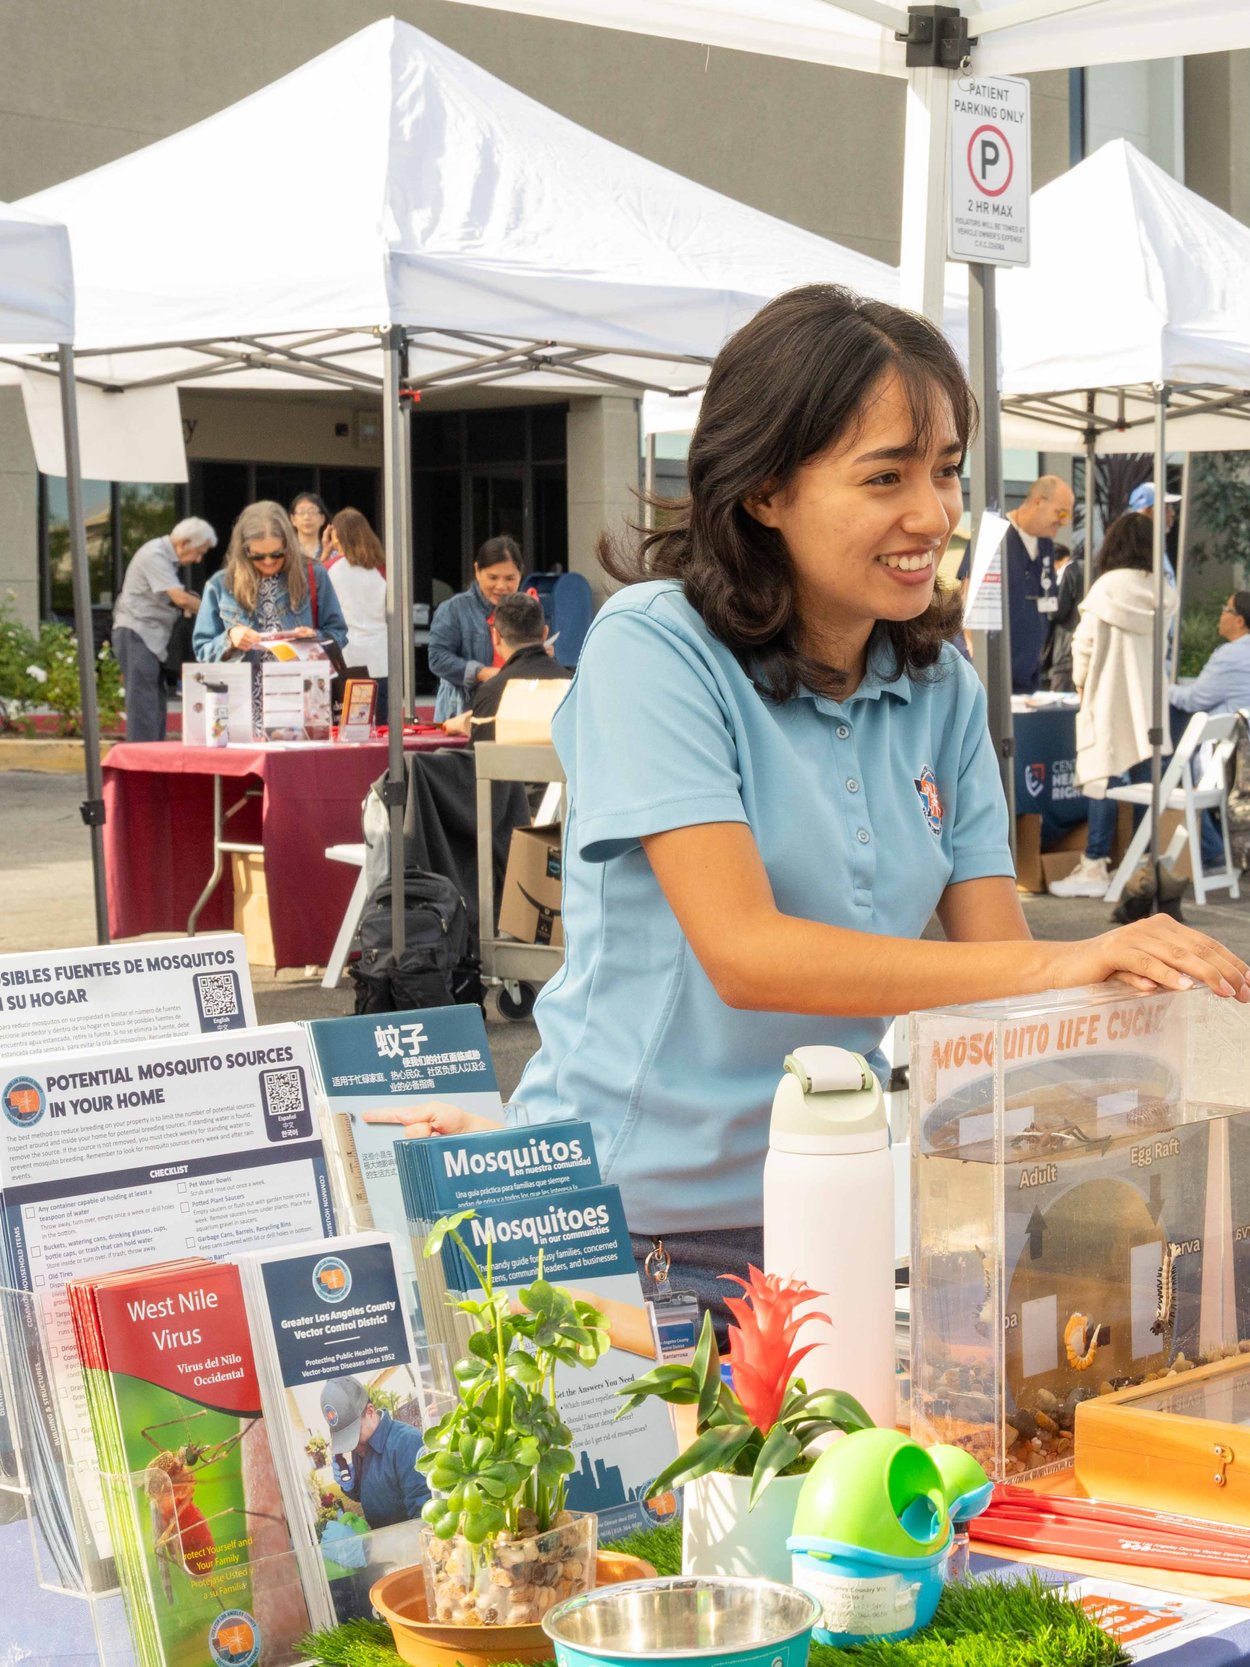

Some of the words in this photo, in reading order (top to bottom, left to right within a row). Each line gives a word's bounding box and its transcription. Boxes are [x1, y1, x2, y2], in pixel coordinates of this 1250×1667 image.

[969, 83, 1009, 101] PATIENT
[954, 99, 997, 118] PARKING
[1000, 108, 1024, 123] ONLY
[981, 140, 1000, 179] P
[968, 200, 973, 211] 2
[976, 201, 989, 214] HR
[992, 204, 1013, 217] MAX
[0, 968, 51, 986] SIBLES
[55, 961, 121, 981] FUENTES
[124, 958, 144, 973] DE
[147, 950, 234, 971] MOSQUITOS
[8, 994, 26, 1011] SU
[31, 989, 88, 1008] HOGAR
[374, 1023, 428, 1058] 蚊子
[931, 1023, 1049, 1070] MOSQUITO
[1056, 1014, 1101, 1050] LIFE
[46, 1067, 133, 1092] POTENTIAL
[138, 1053, 223, 1080] MOSQUITO
[226, 1046, 293, 1068] SOURCES
[390, 1079, 435, 1092] 业的必备指南
[50, 1101, 66, 1118] IN
[72, 1094, 114, 1114] YOUR
[116, 1088, 165, 1108] HOME
[278, 1114, 296, 1122] Español
[443, 1138, 583, 1177] Mosquitos
[1130, 1146, 1152, 1166] Egg
[1154, 1137, 1180, 1160] Raft
[150, 1165, 189, 1179] CHECKLIST
[515, 1168, 524, 1176] en
[526, 1164, 552, 1174] nuestra
[554, 1157, 591, 1170] comunidad
[1019, 1163, 1058, 1190] Adult
[319, 1175, 329, 1205] COMMON
[455, 1190, 466, 1200] Una
[468, 1187, 479, 1199] guía
[480, 1183, 501, 1197] práctica
[502, 1183, 513, 1195] para
[514, 1180, 535, 1191] familias
[536, 1180, 547, 1190] que
[548, 1175, 571, 1188] siempre
[50, 1201, 76, 1211] container
[78, 1198, 98, 1208] capable
[107, 1193, 127, 1201] holding
[471, 1204, 609, 1246] Mosquitoes
[540, 1236, 547, 1245] in
[549, 1233, 561, 1242] our
[563, 1226, 609, 1241] communities
[512, 1254, 529, 1268] guide
[556, 1247, 582, 1258] families,
[584, 1240, 618, 1254] concerned
[544, 1262, 568, 1274] leaders,
[569, 1258, 581, 1269] and
[583, 1252, 618, 1267] businesses
[18, 1249, 33, 1294] HOUSEHOLD
[127, 1297, 175, 1322] West
[178, 1289, 218, 1313] Nile
[281, 1316, 314, 1329] Greater
[315, 1312, 330, 1323] Los
[331, 1307, 365, 1321] Angeles
[366, 1301, 396, 1314] County
[152, 1328, 202, 1351] Virus
[294, 1327, 323, 1340] Vector
[325, 1320, 356, 1334] Control
[358, 1315, 388, 1328] District
[177, 1362, 203, 1374] Virus
[205, 1357, 219, 1369] del
[221, 1353, 242, 1366] Nilo
[302, 1365, 339, 1377] Vector-borne
[340, 1360, 365, 1370] Diseases
[366, 1357, 380, 1365] since
[381, 1354, 395, 1362] 1952
[305, 1354, 336, 1366] Protecting
[336, 1352, 354, 1360] Public
[355, 1348, 373, 1356] Health
[35, 1363, 50, 1405] STRUCTURES
[194, 1368, 244, 1386] Occidental
[554, 1388, 566, 1399] Get
[567, 1387, 576, 1396] the
[578, 1381, 604, 1395] Answers
[604, 1377, 618, 1387] You
[619, 1374, 635, 1385] Need
[49, 1414, 60, 1446] BUILDING
[572, 1440, 583, 1449] How
[584, 1438, 591, 1446] do
[611, 1431, 617, 1439] of
[618, 1424, 648, 1439] mosquitoes?
[184, 1547, 209, 1560] rotect
[207, 1542, 236, 1553] Yourself
[238, 1536, 253, 1546] and
[196, 1560, 213, 1570] Your
[214, 1554, 240, 1566] Family
[226, 1568, 248, 1580] Usted
[219, 1583, 247, 1595] Familia
